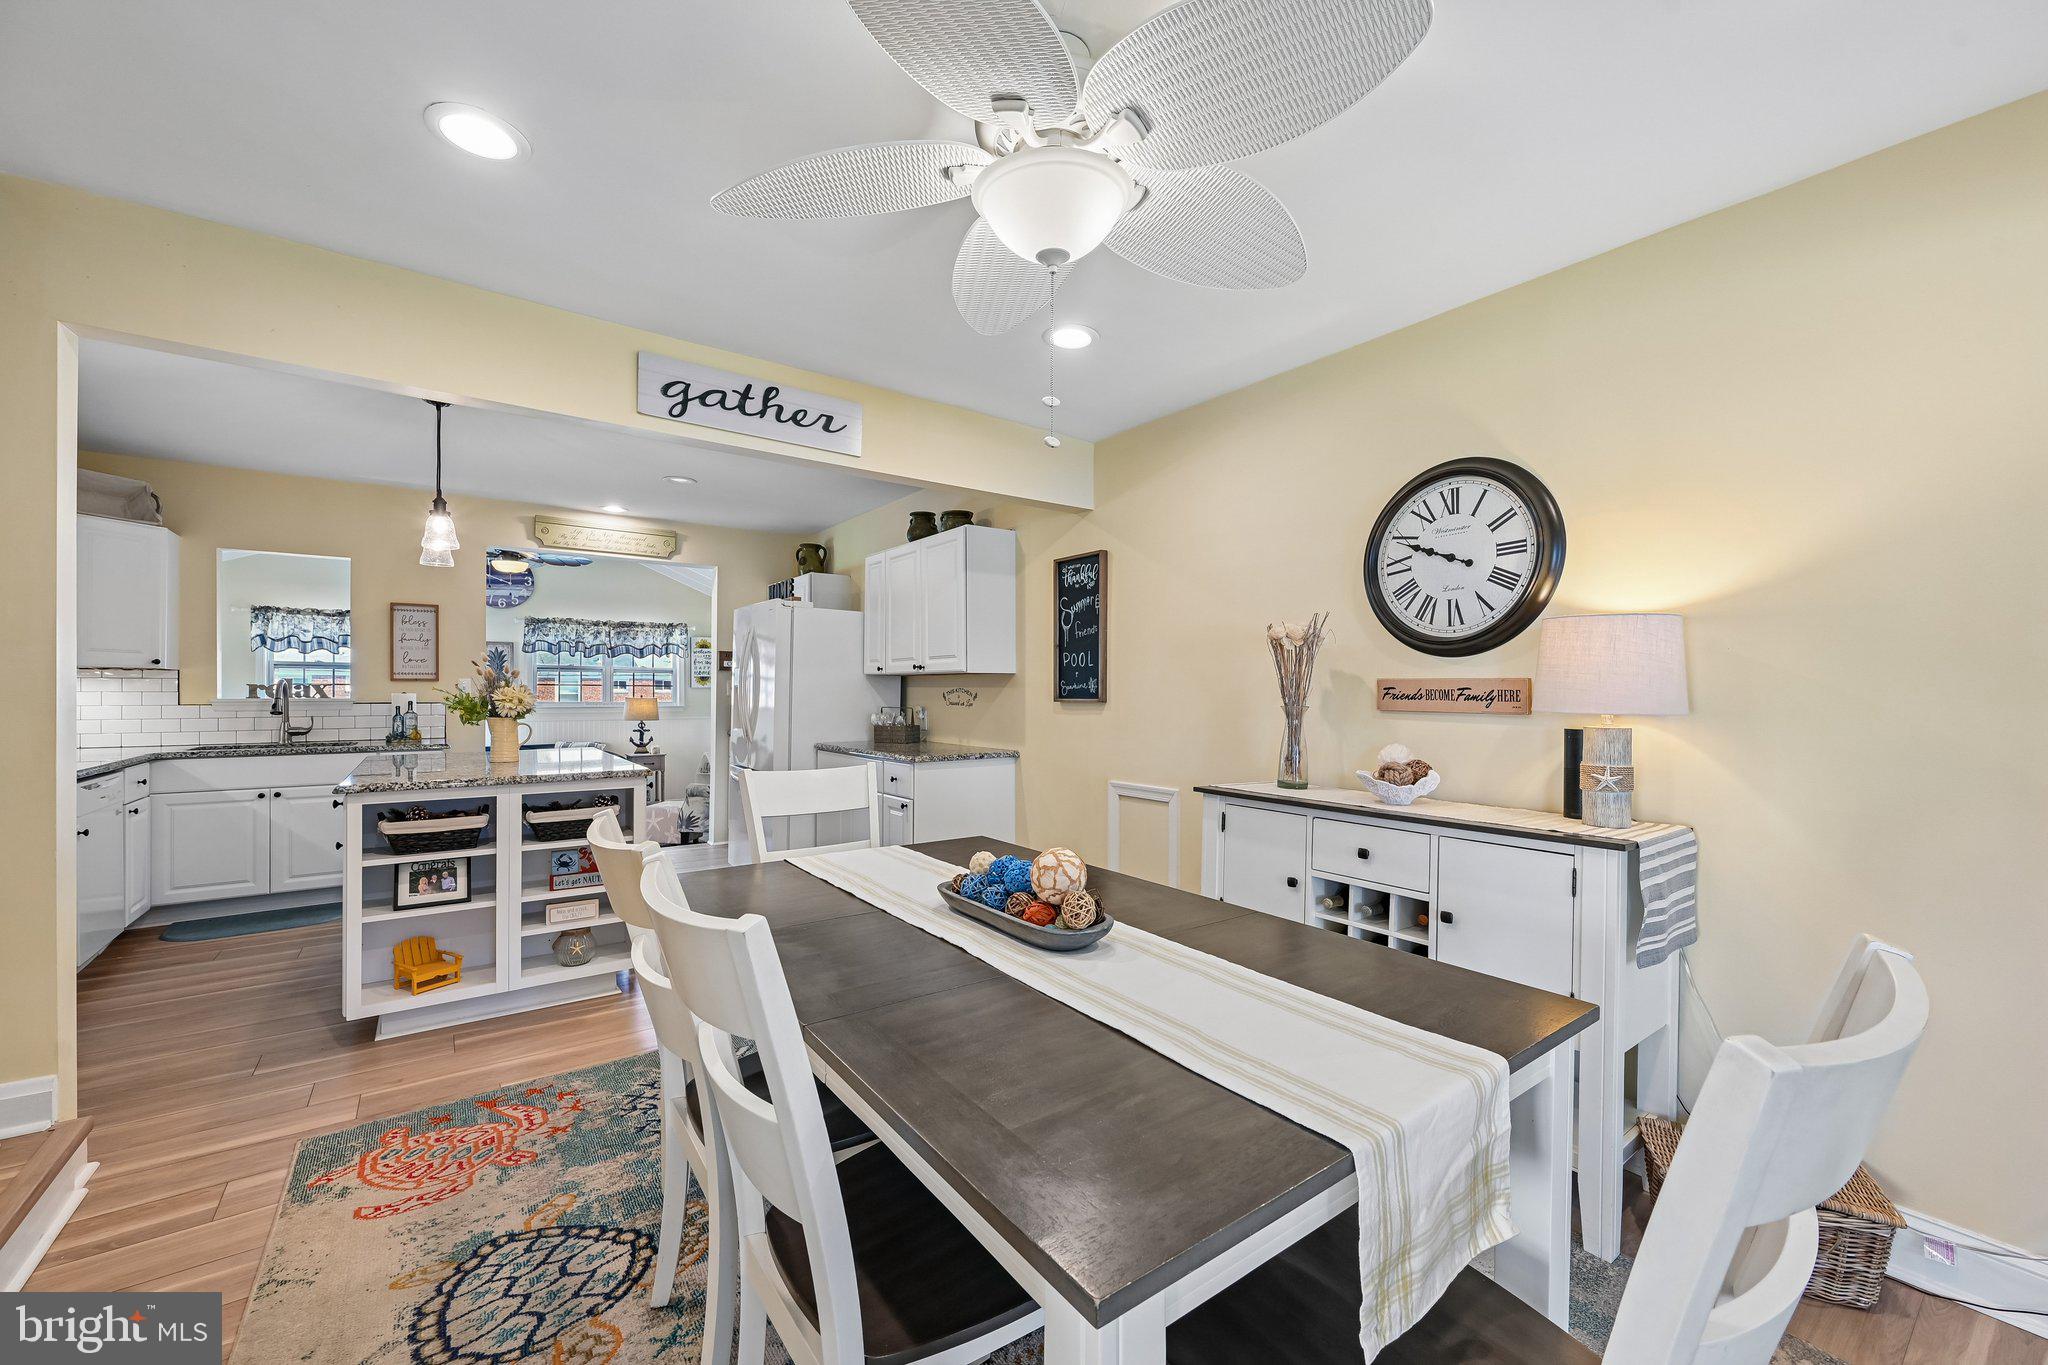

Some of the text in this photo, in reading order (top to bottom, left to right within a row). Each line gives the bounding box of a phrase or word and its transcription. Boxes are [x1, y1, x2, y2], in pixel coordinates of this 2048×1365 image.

[660, 380, 848, 434] gather
[1438, 486, 1463, 518] XII
[1410, 499, 1438, 532] XI
[1486, 505, 1519, 533] II
[1496, 537, 1528, 557] III
[1386, 554, 1414, 578] IX
[524, 576, 532, 587] 3
[1442, 584, 1465, 592] London
[498, 598, 507, 608] 6
[511, 594, 519, 605] 5
[1392, 577, 1422, 611] VIII
[1474, 590, 1497, 618] V
[1413, 593, 1438, 625] VII
[1446, 598, 1465, 627] VI
[401, 615, 428, 628] bless
[399, 633, 432, 647] family
[403, 651, 428, 664] love
[1063, 651, 1094, 667] POOL
[1382, 686, 1522, 709] Friends BECOME Family HERE
[411, 859, 456, 873] Congrats
[554, 876, 570, 887] Let's
[571, 877, 581, 887] get
